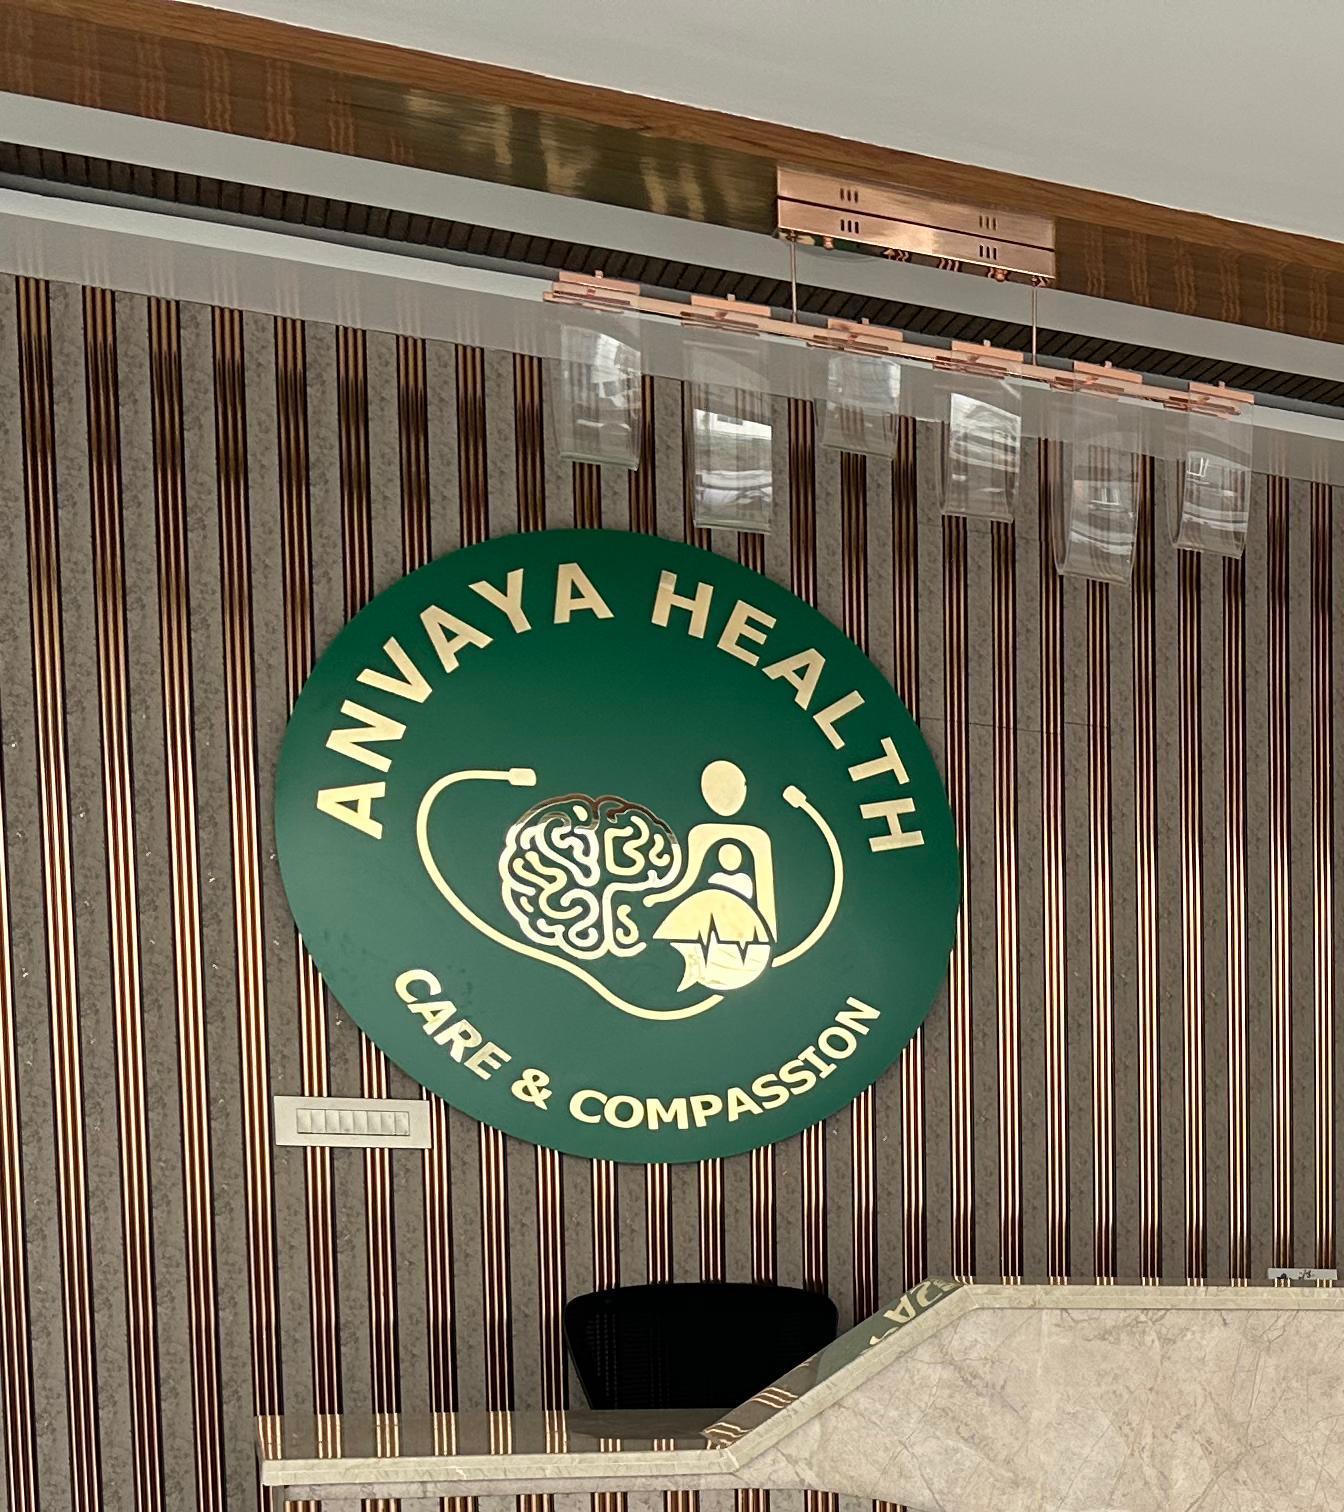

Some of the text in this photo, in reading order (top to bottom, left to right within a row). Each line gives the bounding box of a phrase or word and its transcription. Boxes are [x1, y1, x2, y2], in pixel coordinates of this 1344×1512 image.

[316, 562, 926, 854] ANVAYA HEALTH
[393, 967, 882, 1131] CARE & COMPASSION
